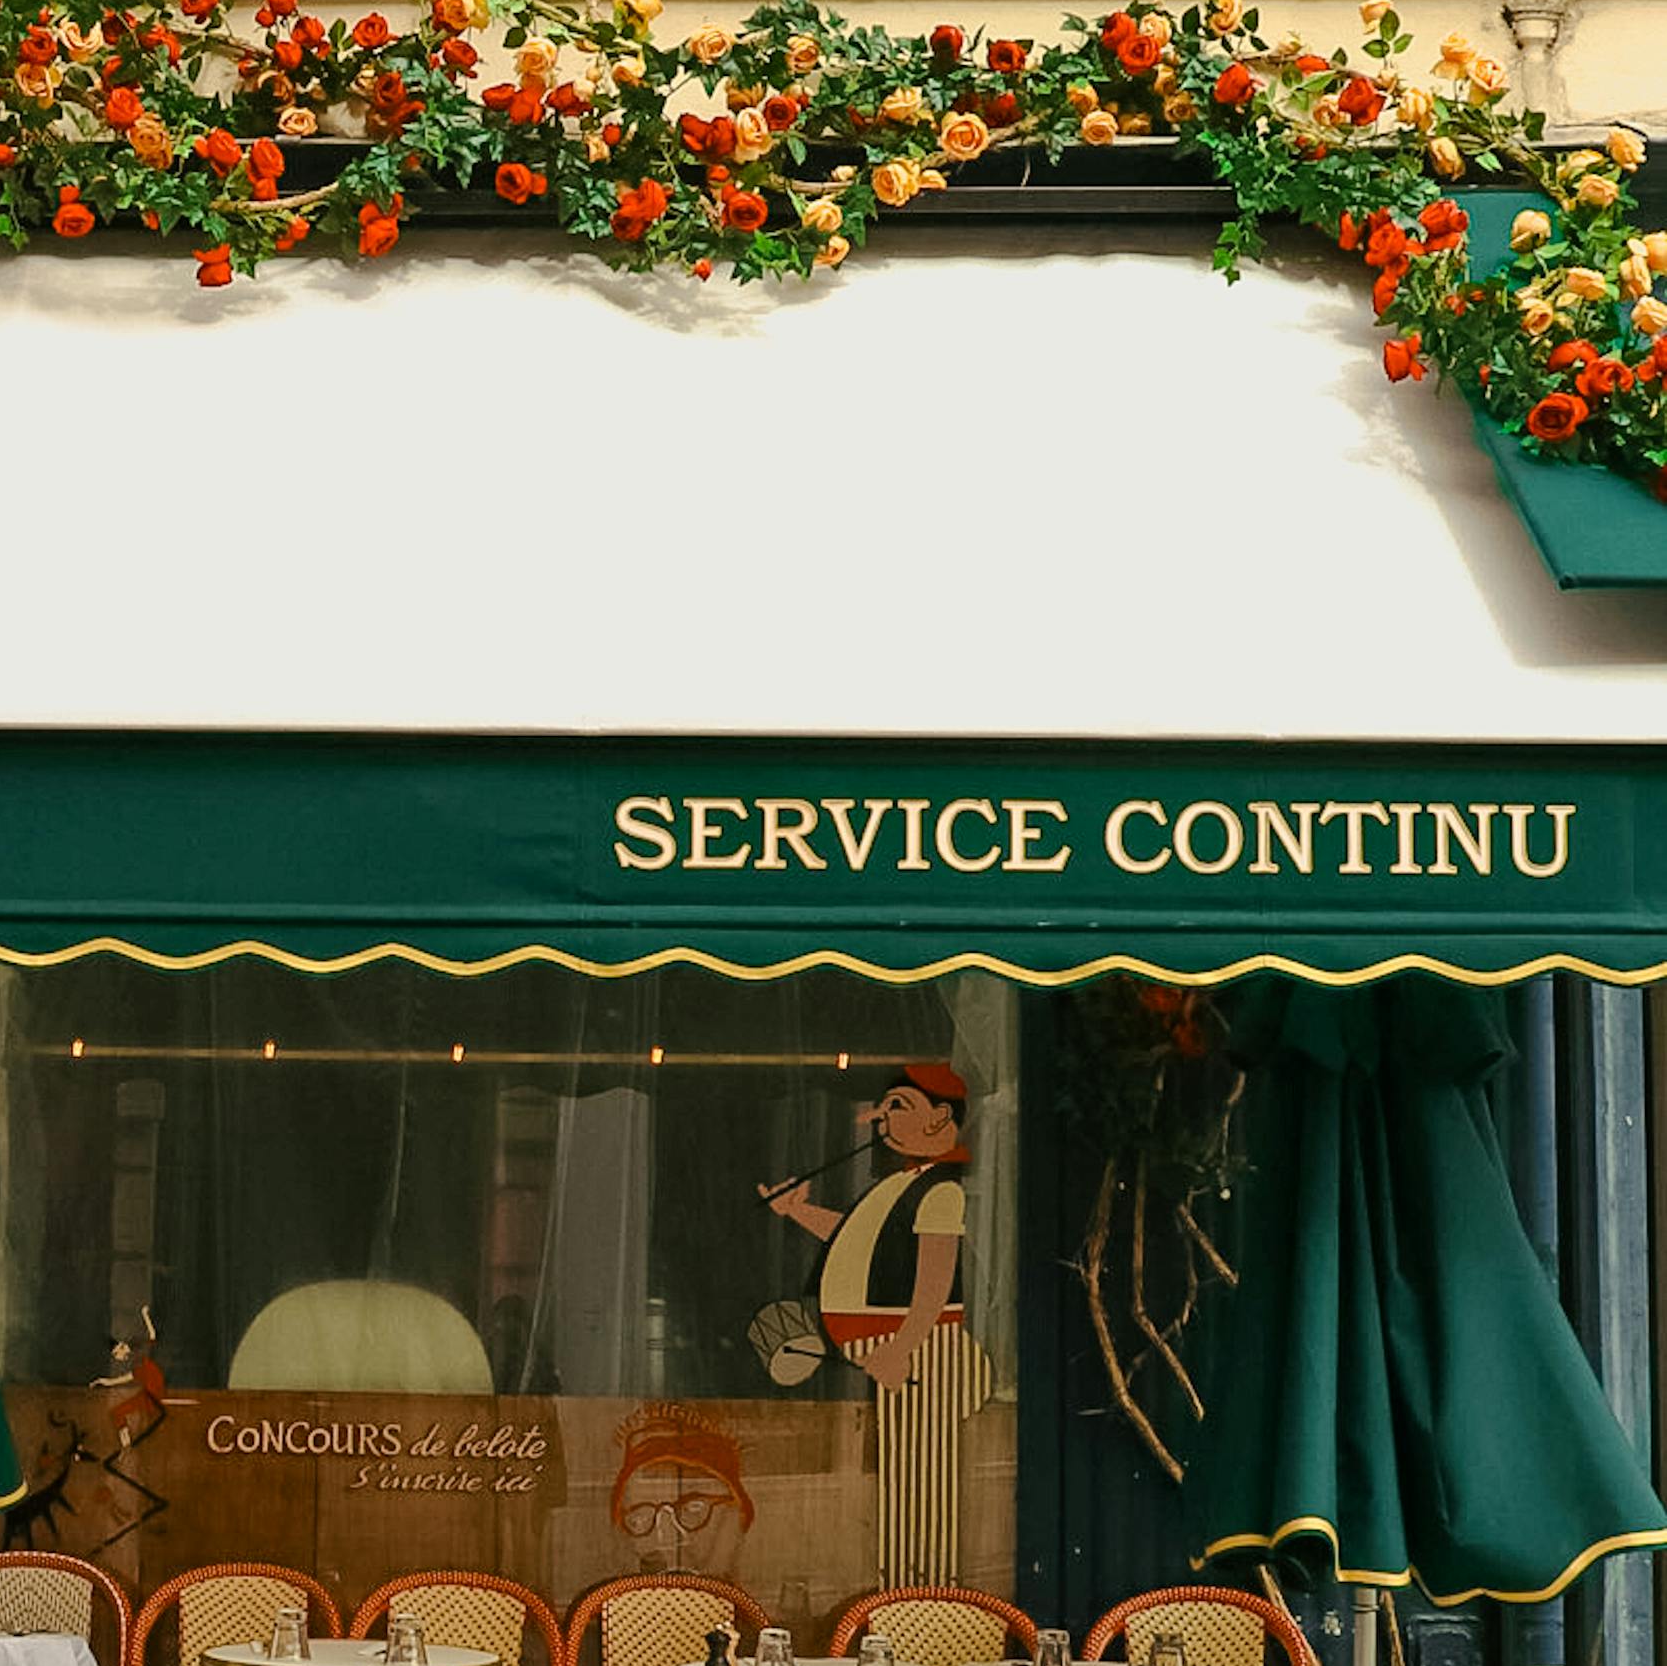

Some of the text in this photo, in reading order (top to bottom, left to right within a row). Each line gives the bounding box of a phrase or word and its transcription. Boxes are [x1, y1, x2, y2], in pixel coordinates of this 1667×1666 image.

[614, 795, 1576, 878] SERVICE CONTINU
[410, 1424, 447, 1458] de
[453, 1424, 547, 1460] belote
[494, 1464, 543, 1492] ici
